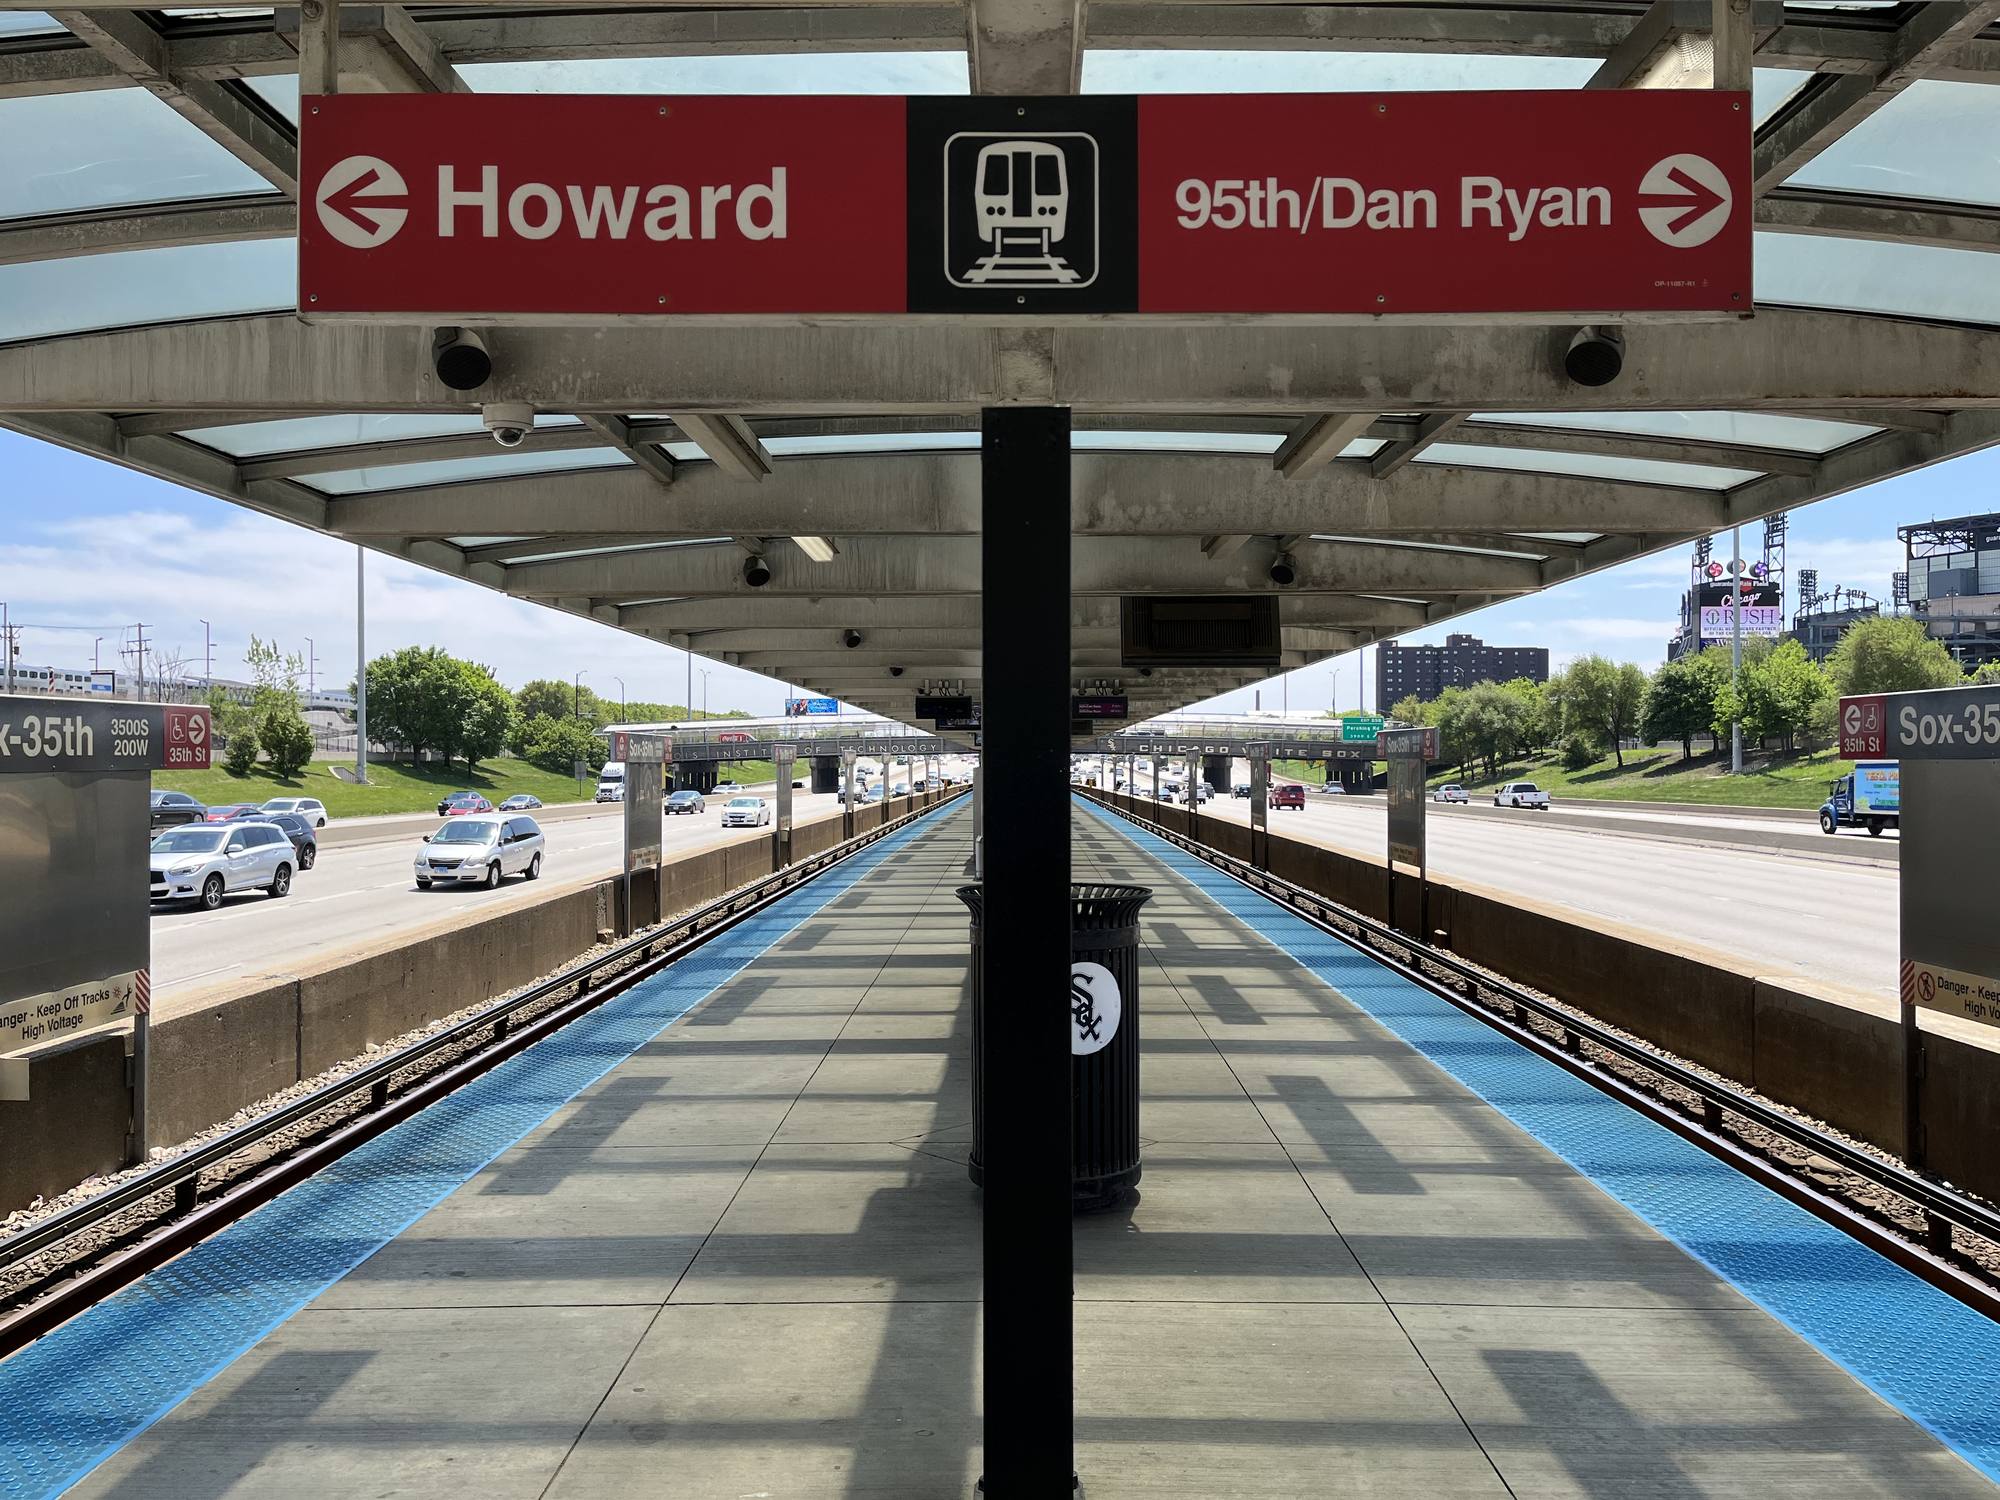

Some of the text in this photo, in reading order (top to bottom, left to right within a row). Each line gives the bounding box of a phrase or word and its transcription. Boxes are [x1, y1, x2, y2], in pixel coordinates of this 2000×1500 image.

[438, 164, 788, 242] Howard
[1175, 175, 1612, 242] 95th/Dan Ryan
[111, 719, 149, 737] 3500S
[114, 739, 149, 757] 200W
[804, 746, 821, 754] OF
[840, 744, 937, 753] TECHNOLOGY
[1139, 744, 1229, 754] CHICGO
[1322, 749, 1361, 759] SOX
[1844, 736, 1880, 753] 35th St
[169, 746, 206, 763] 35th St
[1937, 976, 1969, 996] Danger
[36, 1001, 61, 1018] Keep
[64, 994, 79, 1011] Off
[81, 989, 110, 1006] Tracks
[1964, 999, 1986, 1018] High
[22, 1013, 83, 1040] High Voltage
